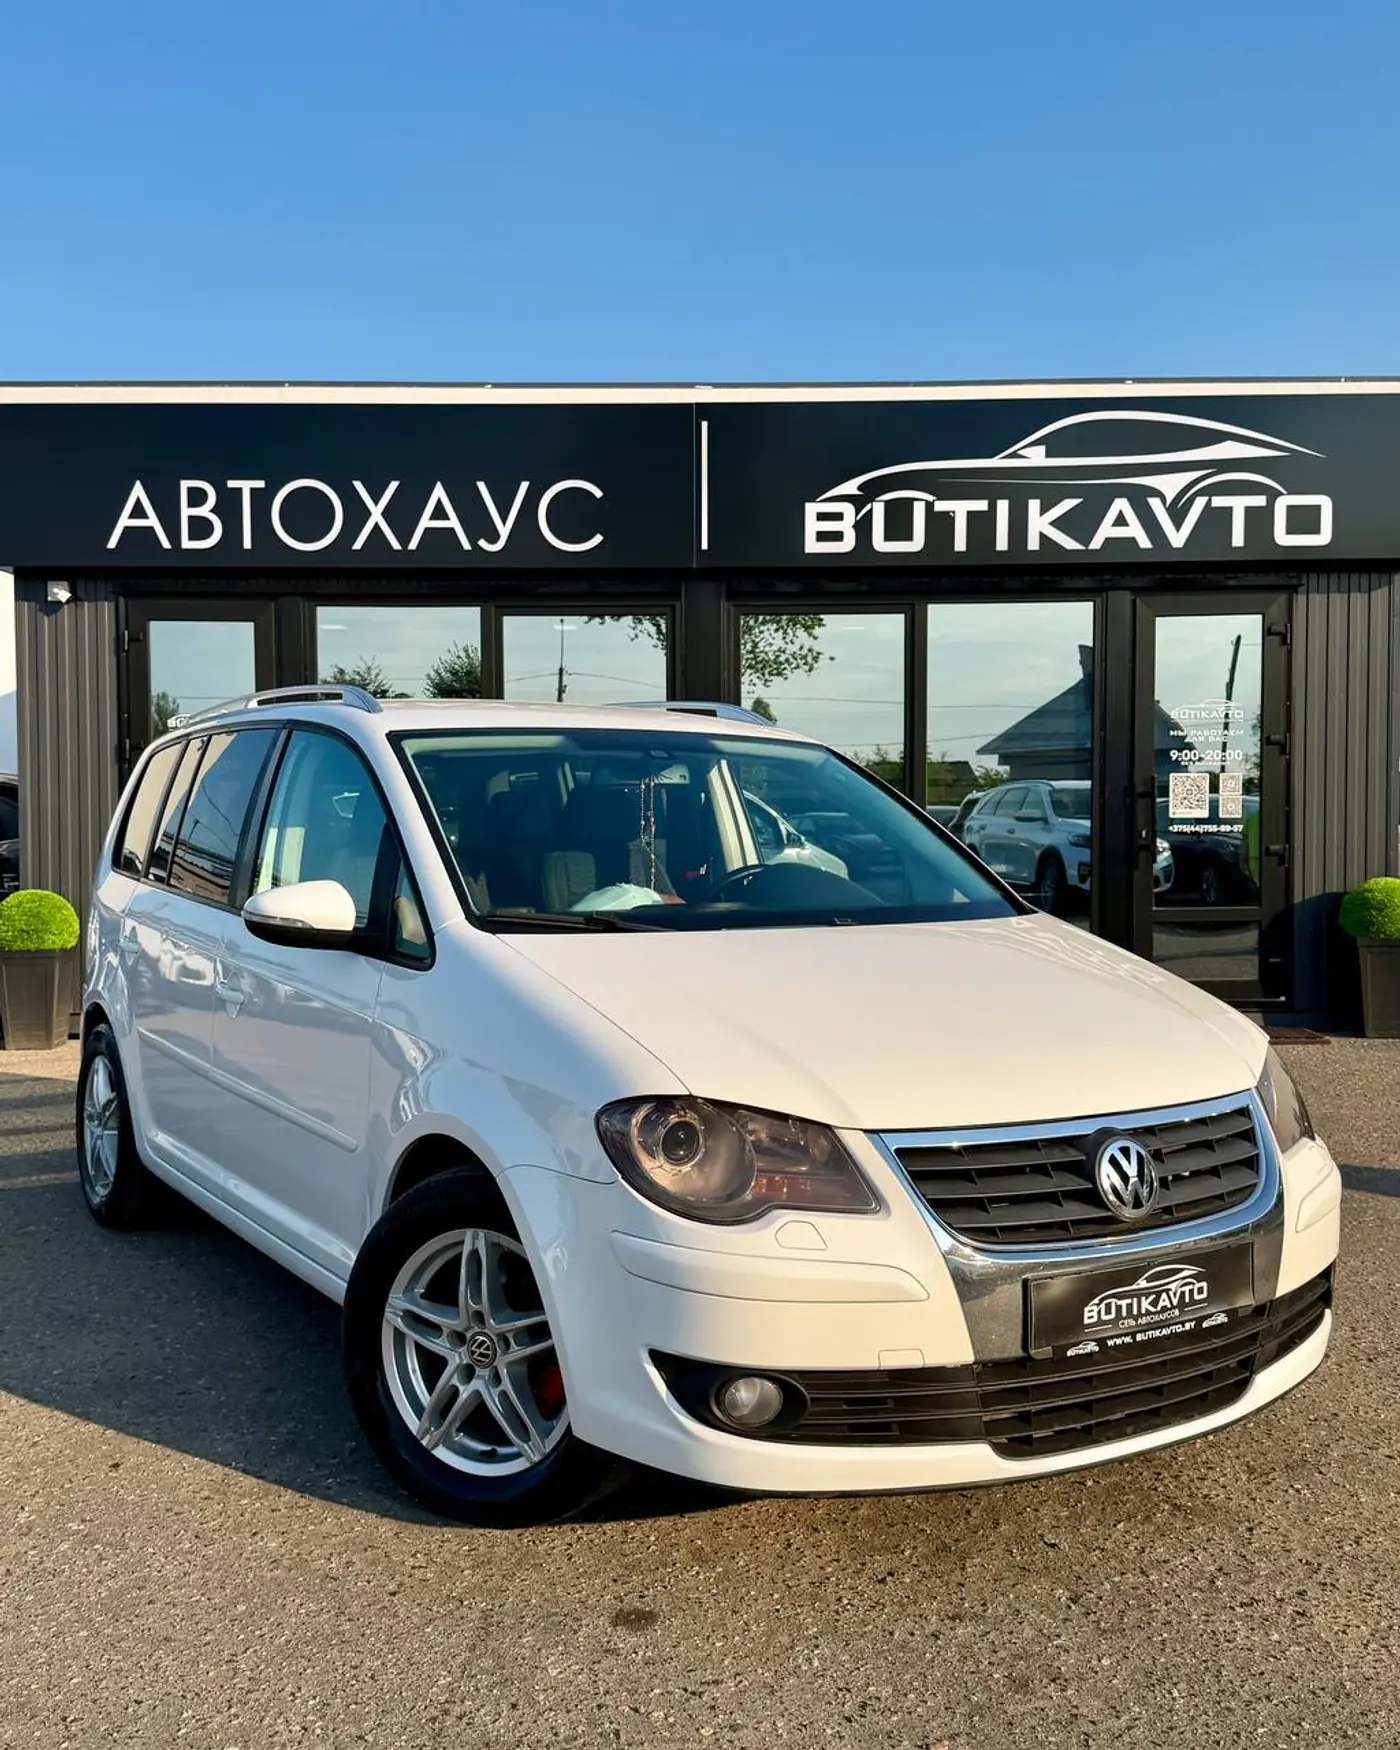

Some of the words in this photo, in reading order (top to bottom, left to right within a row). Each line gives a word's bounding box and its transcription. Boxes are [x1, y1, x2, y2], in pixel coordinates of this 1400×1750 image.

[106, 479, 604, 552] АВТОХАУС
[804, 494, 1333, 554] BUTIKAVTO
[1169, 749, 1243, 761] 9:00-20:00
[1083, 1281, 1208, 1325] BUTIKAVTO
